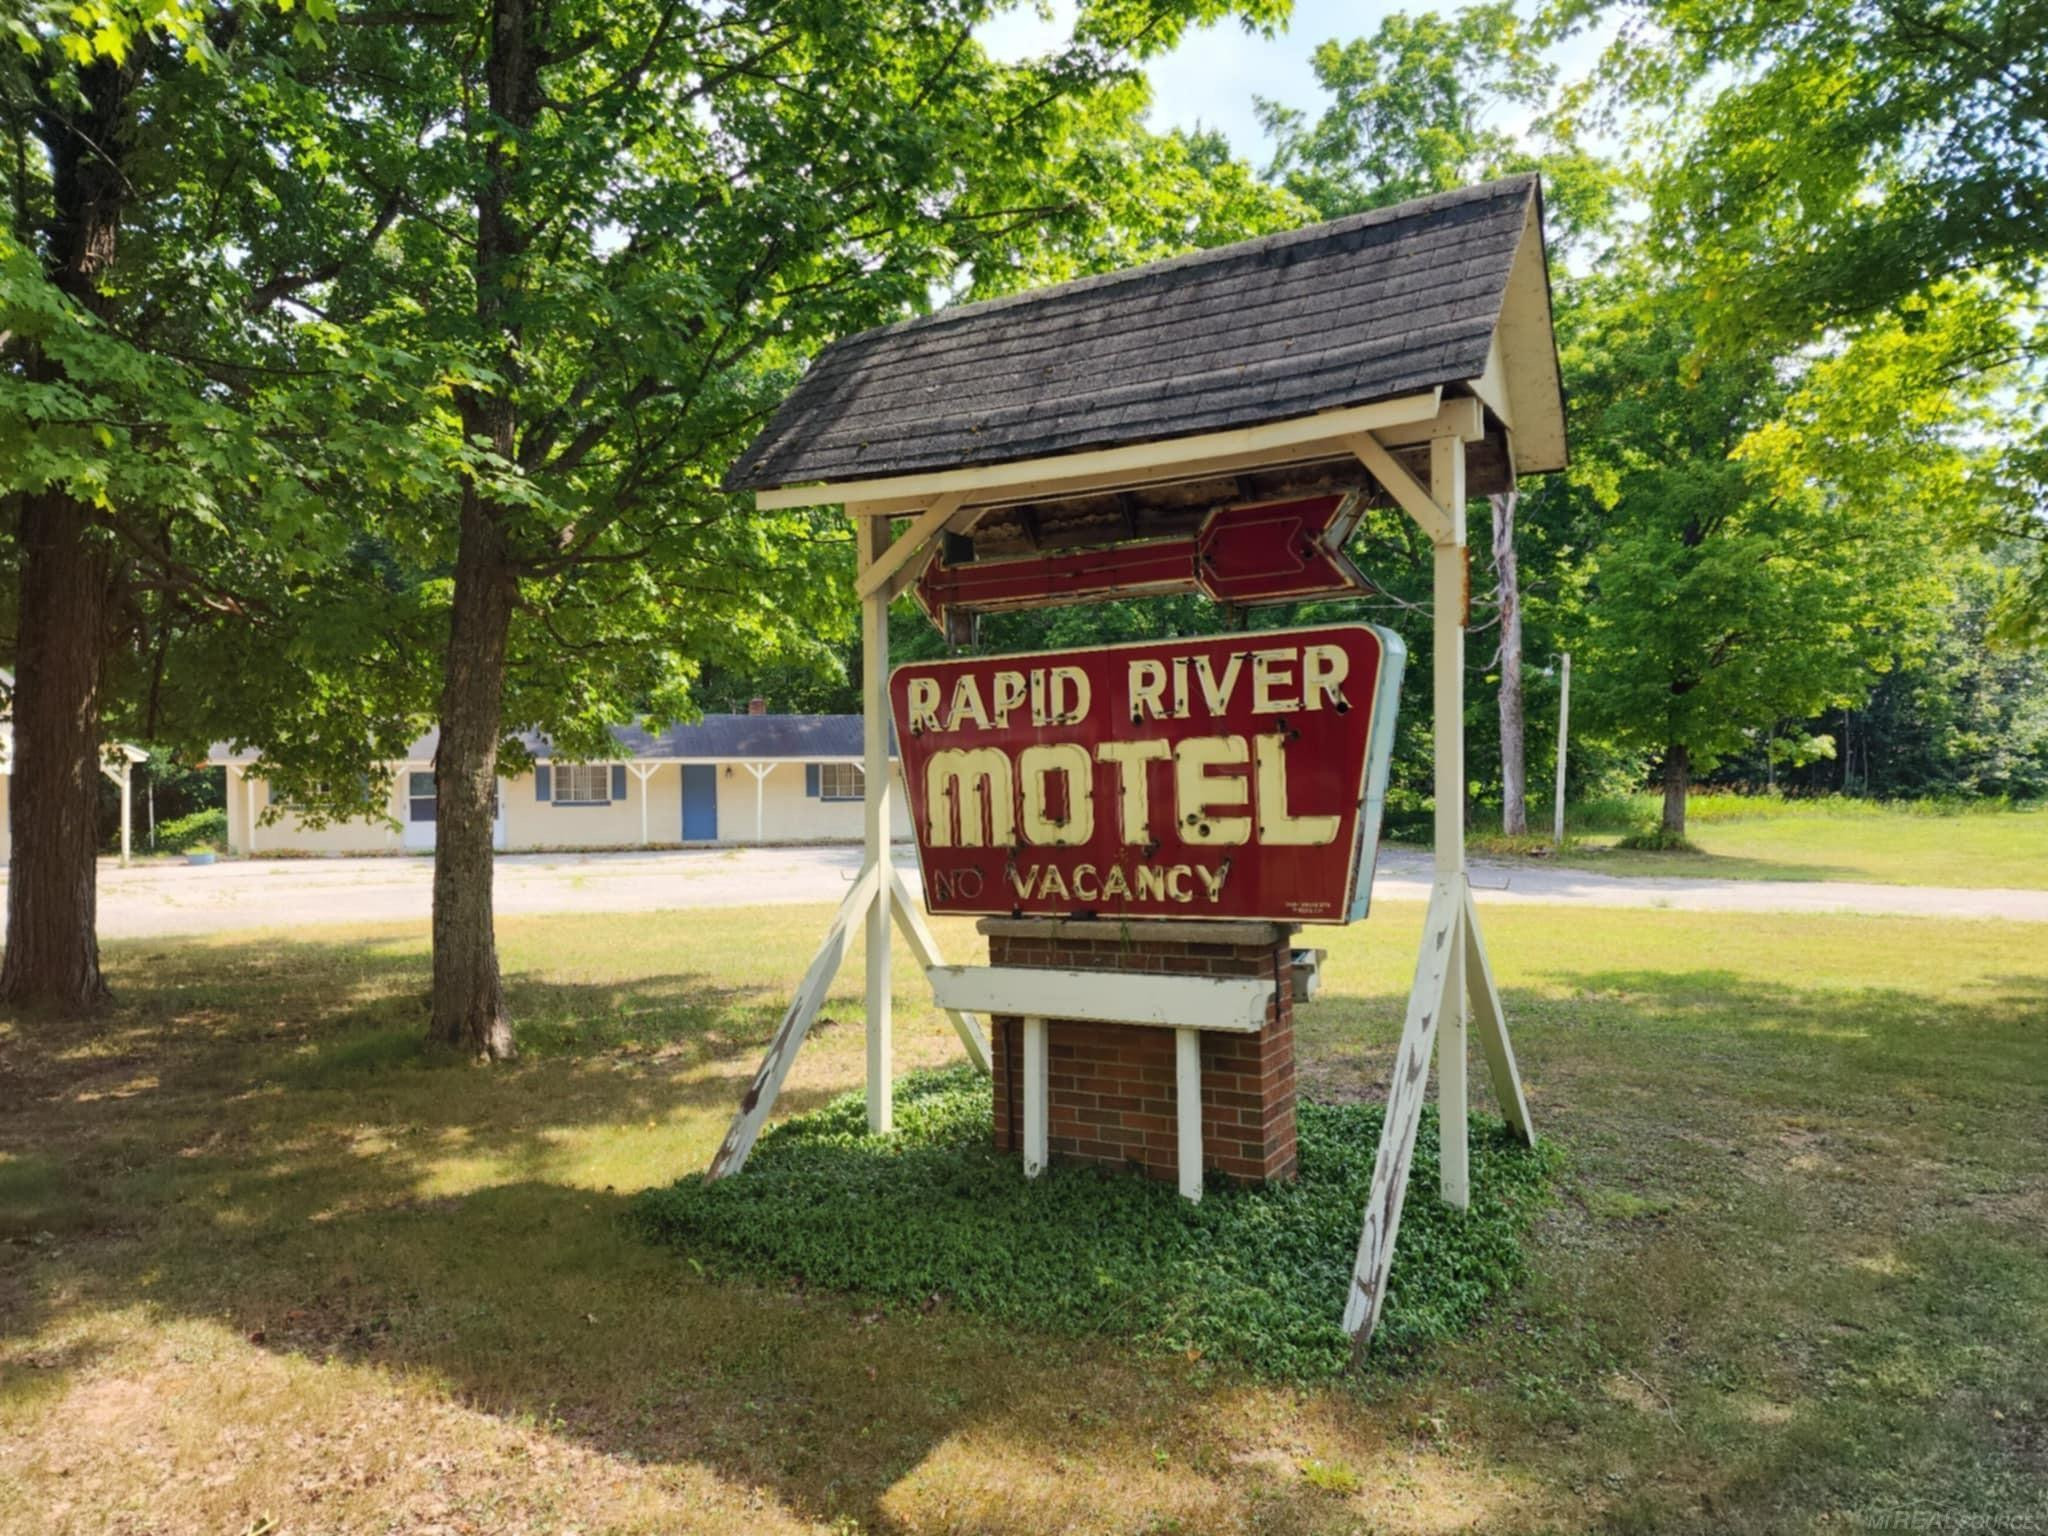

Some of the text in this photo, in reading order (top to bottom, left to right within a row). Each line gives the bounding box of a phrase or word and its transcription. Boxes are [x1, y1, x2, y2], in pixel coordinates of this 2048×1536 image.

[907, 644, 1353, 732] RAPID RIVER
[924, 734, 1341, 848] MOTEL
[934, 863, 1230, 903] NO VACANCY
